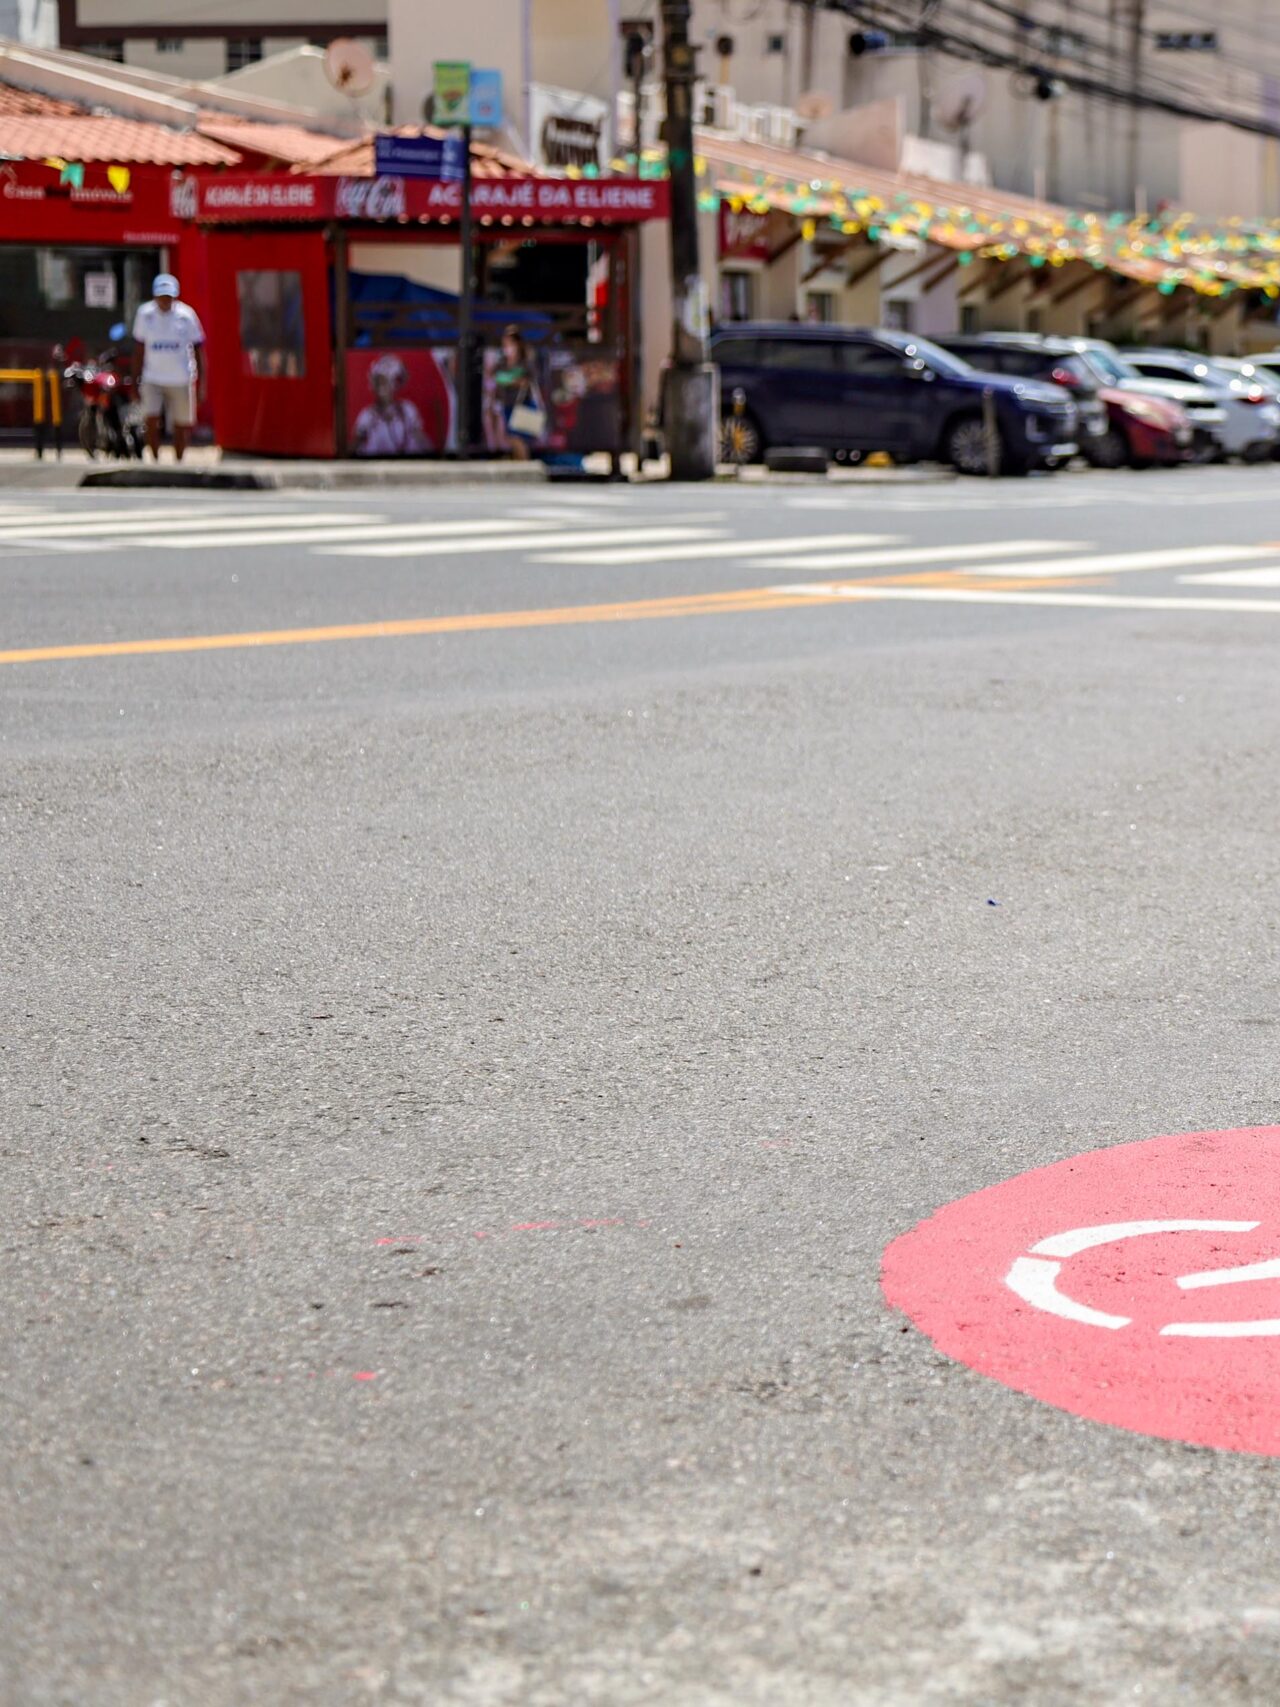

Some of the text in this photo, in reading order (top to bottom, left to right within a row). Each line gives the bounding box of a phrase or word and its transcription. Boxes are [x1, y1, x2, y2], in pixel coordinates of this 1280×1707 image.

[428, 182, 654, 208] ACRAJÉ DA ELIENE
